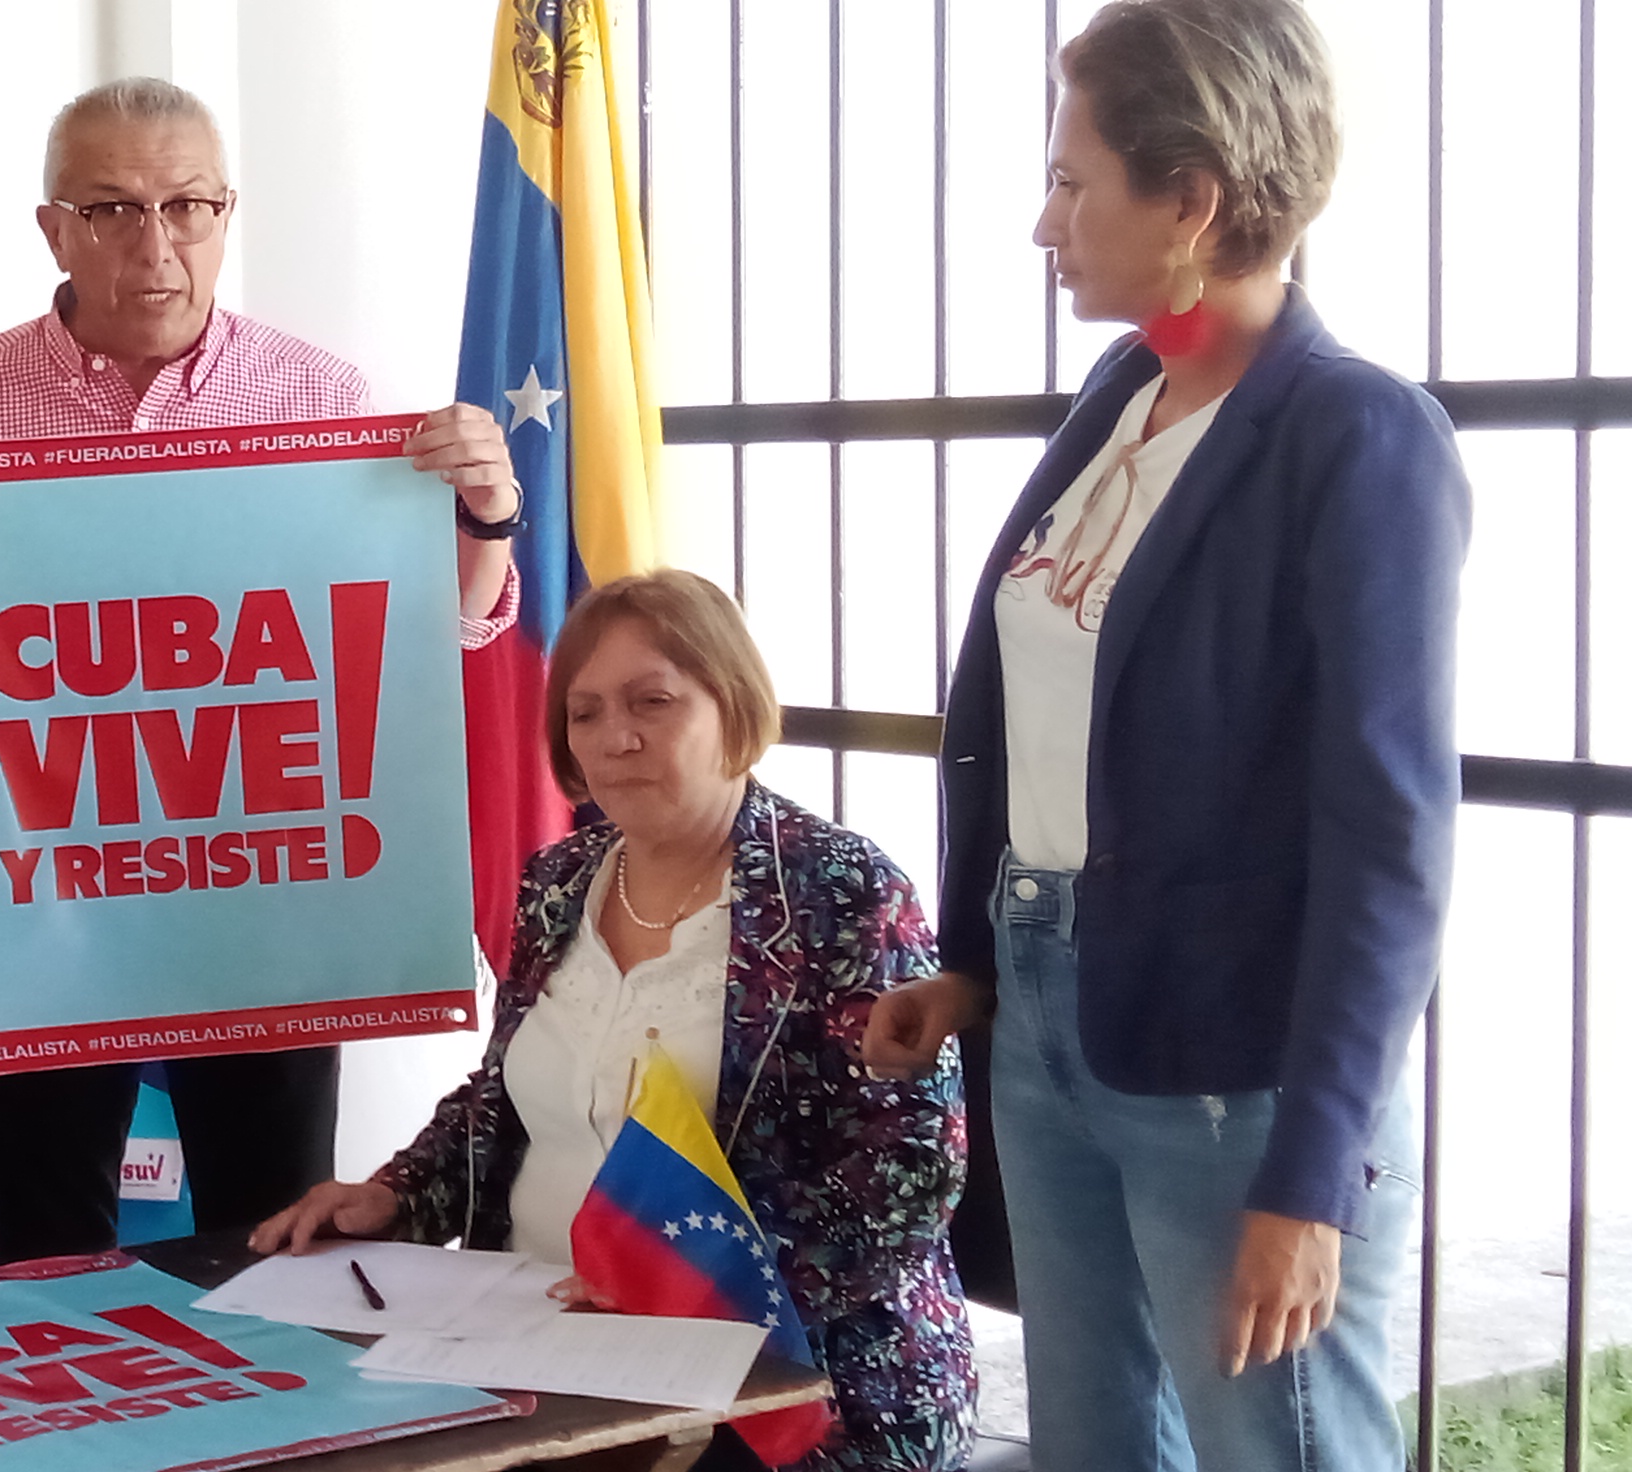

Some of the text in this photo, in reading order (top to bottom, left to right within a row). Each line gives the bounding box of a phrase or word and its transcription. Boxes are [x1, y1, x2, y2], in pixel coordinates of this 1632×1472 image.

[44, 439, 231, 465] #FUERADELALISTA
[239, 427, 414, 452] #FUERADELALIST
[54, 826, 329, 900] RESISTE
[89, 1023, 267, 1052] #FUERADELALISTA
